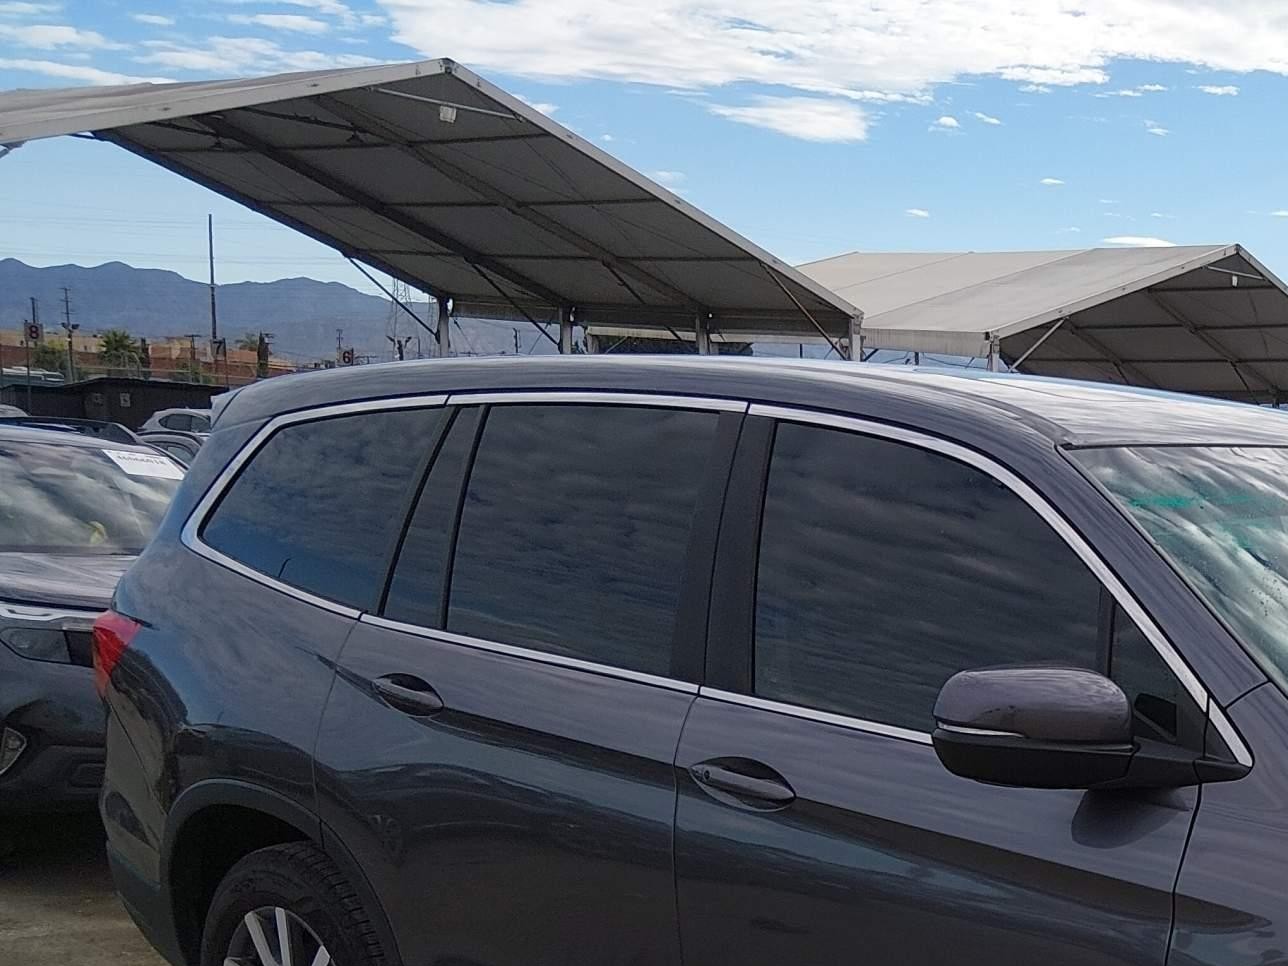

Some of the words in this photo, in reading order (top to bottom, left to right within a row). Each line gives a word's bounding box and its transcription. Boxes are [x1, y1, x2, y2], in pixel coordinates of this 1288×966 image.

[29, 325, 39, 339] 8
[213, 340, 223, 354] 7
[342, 350, 351, 364] 6
